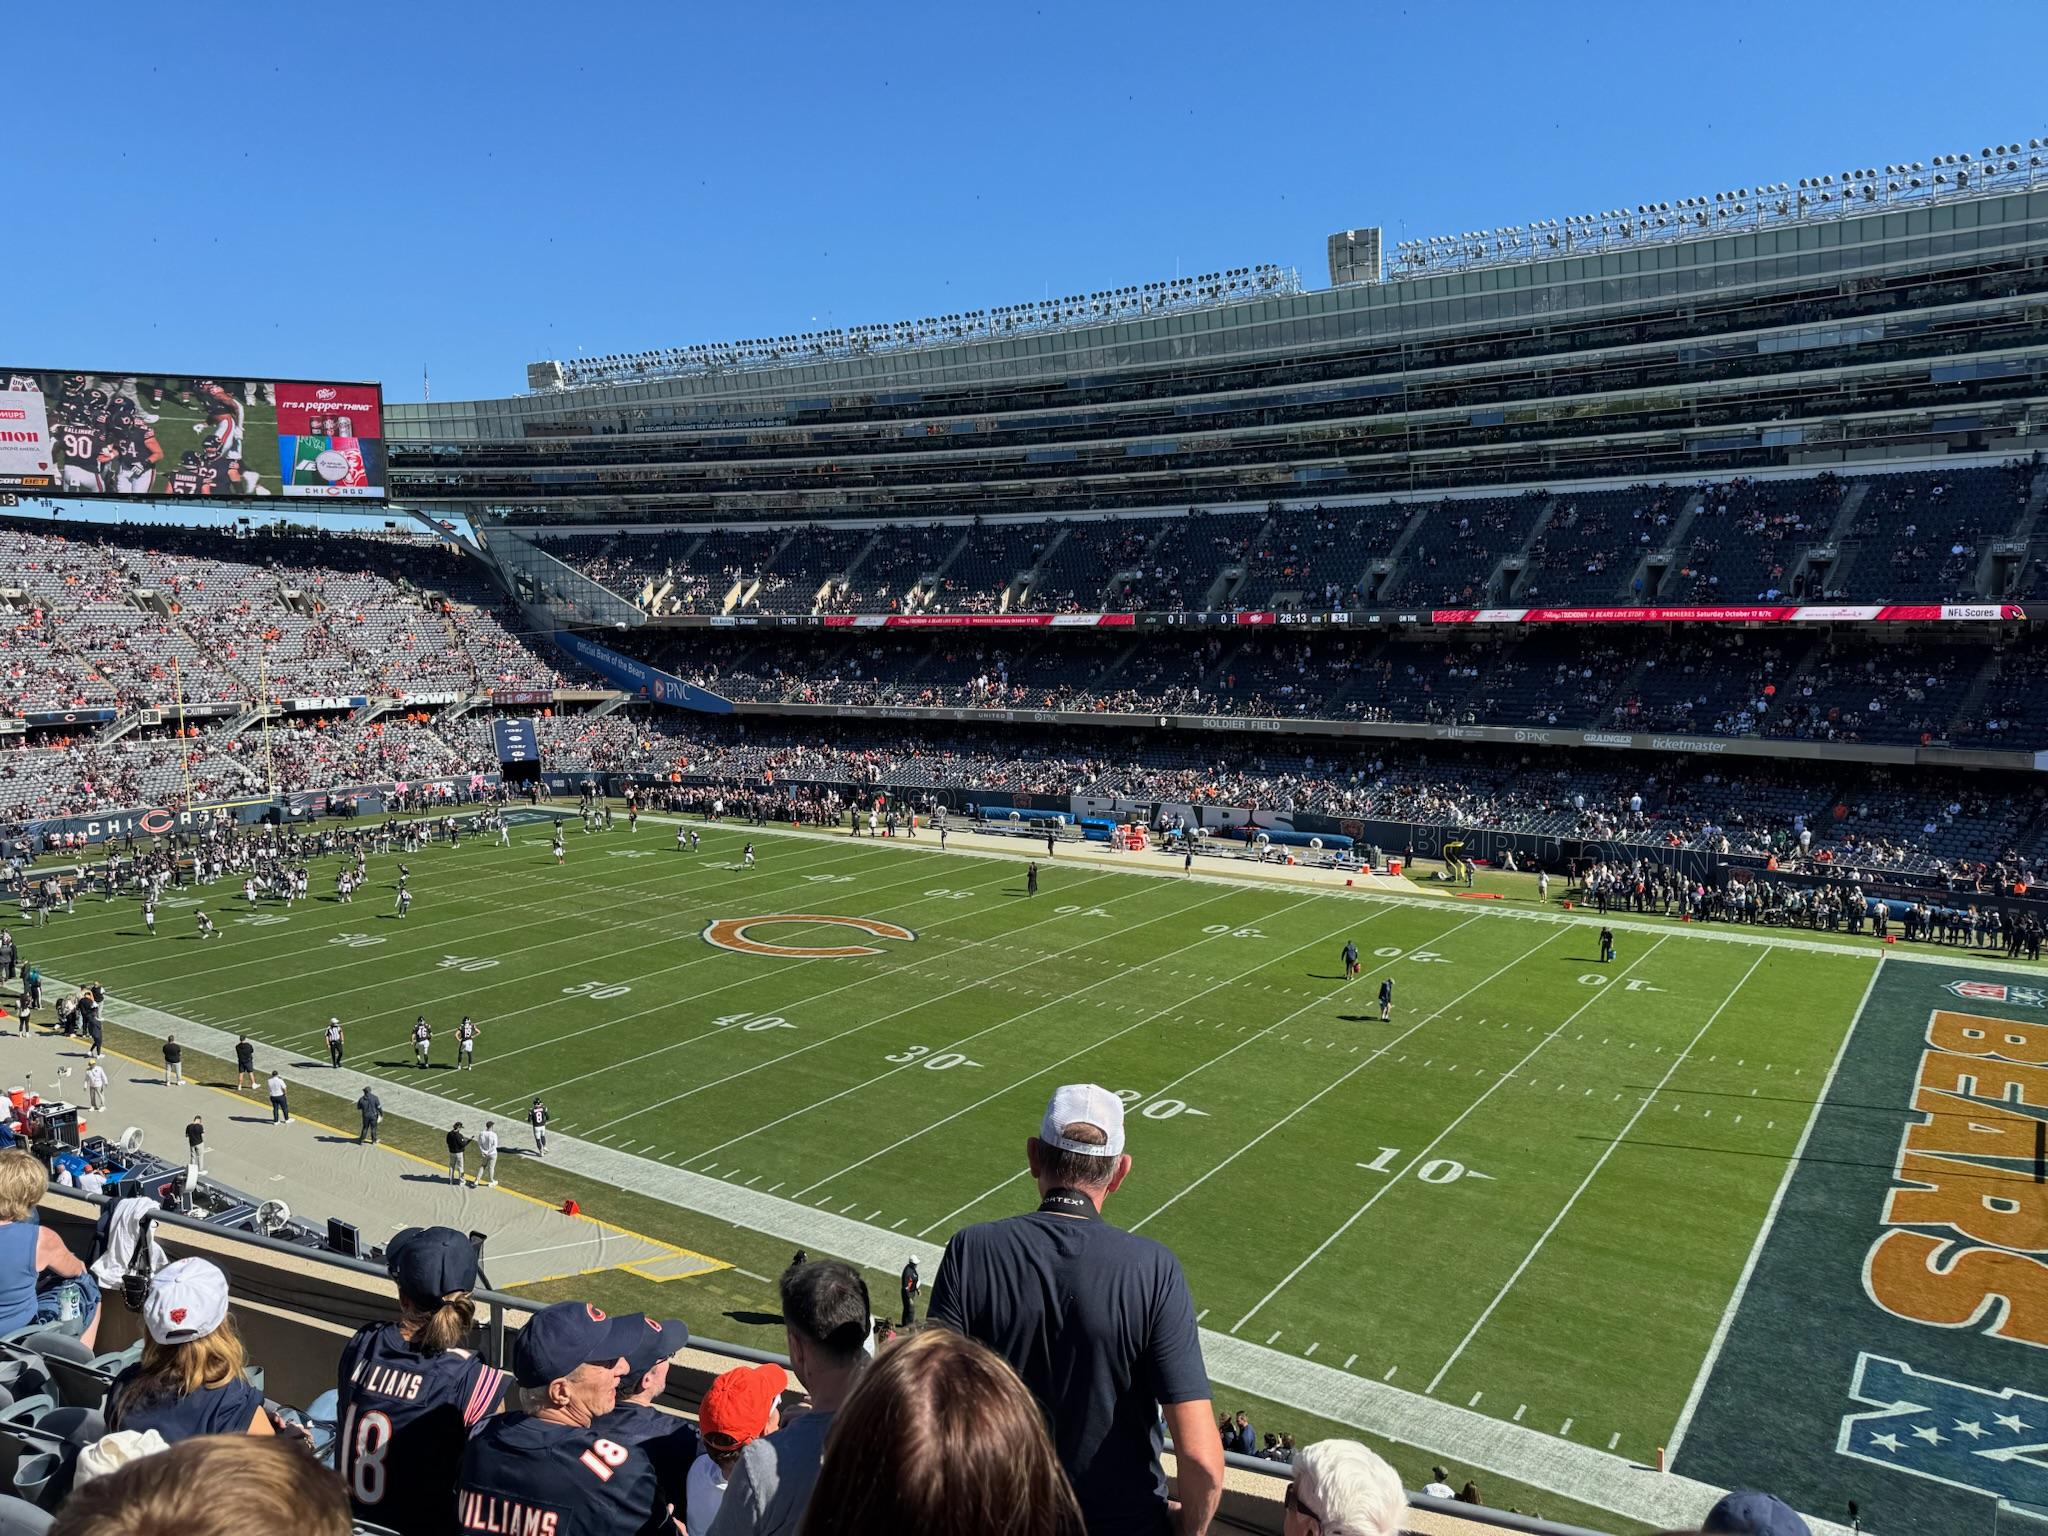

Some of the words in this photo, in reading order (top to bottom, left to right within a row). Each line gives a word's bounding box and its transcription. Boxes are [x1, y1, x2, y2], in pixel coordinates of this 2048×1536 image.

[305, 401, 342, 412] pepper
[64, 434, 93, 459] 90
[1168, 614, 1174, 624] 0
[1220, 614, 1227, 624] 0
[1280, 613, 1307, 624] 28:13
[1696, 610, 1724, 619] Saturday
[1725, 609, 1750, 618] October
[1948, 608, 1963, 617] NFL
[1965, 608, 1994, 617] Scores
[577, 641, 596, 658] Official
[596, 649, 611, 664] Bank
[628, 662, 646, 680] Bears
[666, 682, 691, 700] PNC
[295, 698, 350, 710] BEAR
[888, 709, 918, 717] Advocate
[1202, 719, 1246, 729] SOLDIER
[1251, 720, 1280, 730] FIELD
[1447, 727, 1464, 738] Lite
[1527, 732, 1550, 742] PNC
[1583, 733, 1633, 744] GRAINGER
[1652, 737, 1727, 752] ticketmaster
[1201, 924, 1261, 939] 30
[1373, 946, 1442, 963] 20
[562, 980, 632, 1000] 50
[711, 1011, 786, 1032] 40
[884, 1045, 967, 1071] 30
[1113, 1088, 1188, 1120] 20
[1356, 1146, 1465, 1184] 10
[1861, 1009, 2048, 1348] BEARS
[351, 1359, 423, 1400] WLLIAMS
[340, 1402, 393, 1506] 18
[579, 1438, 629, 1482] 18
